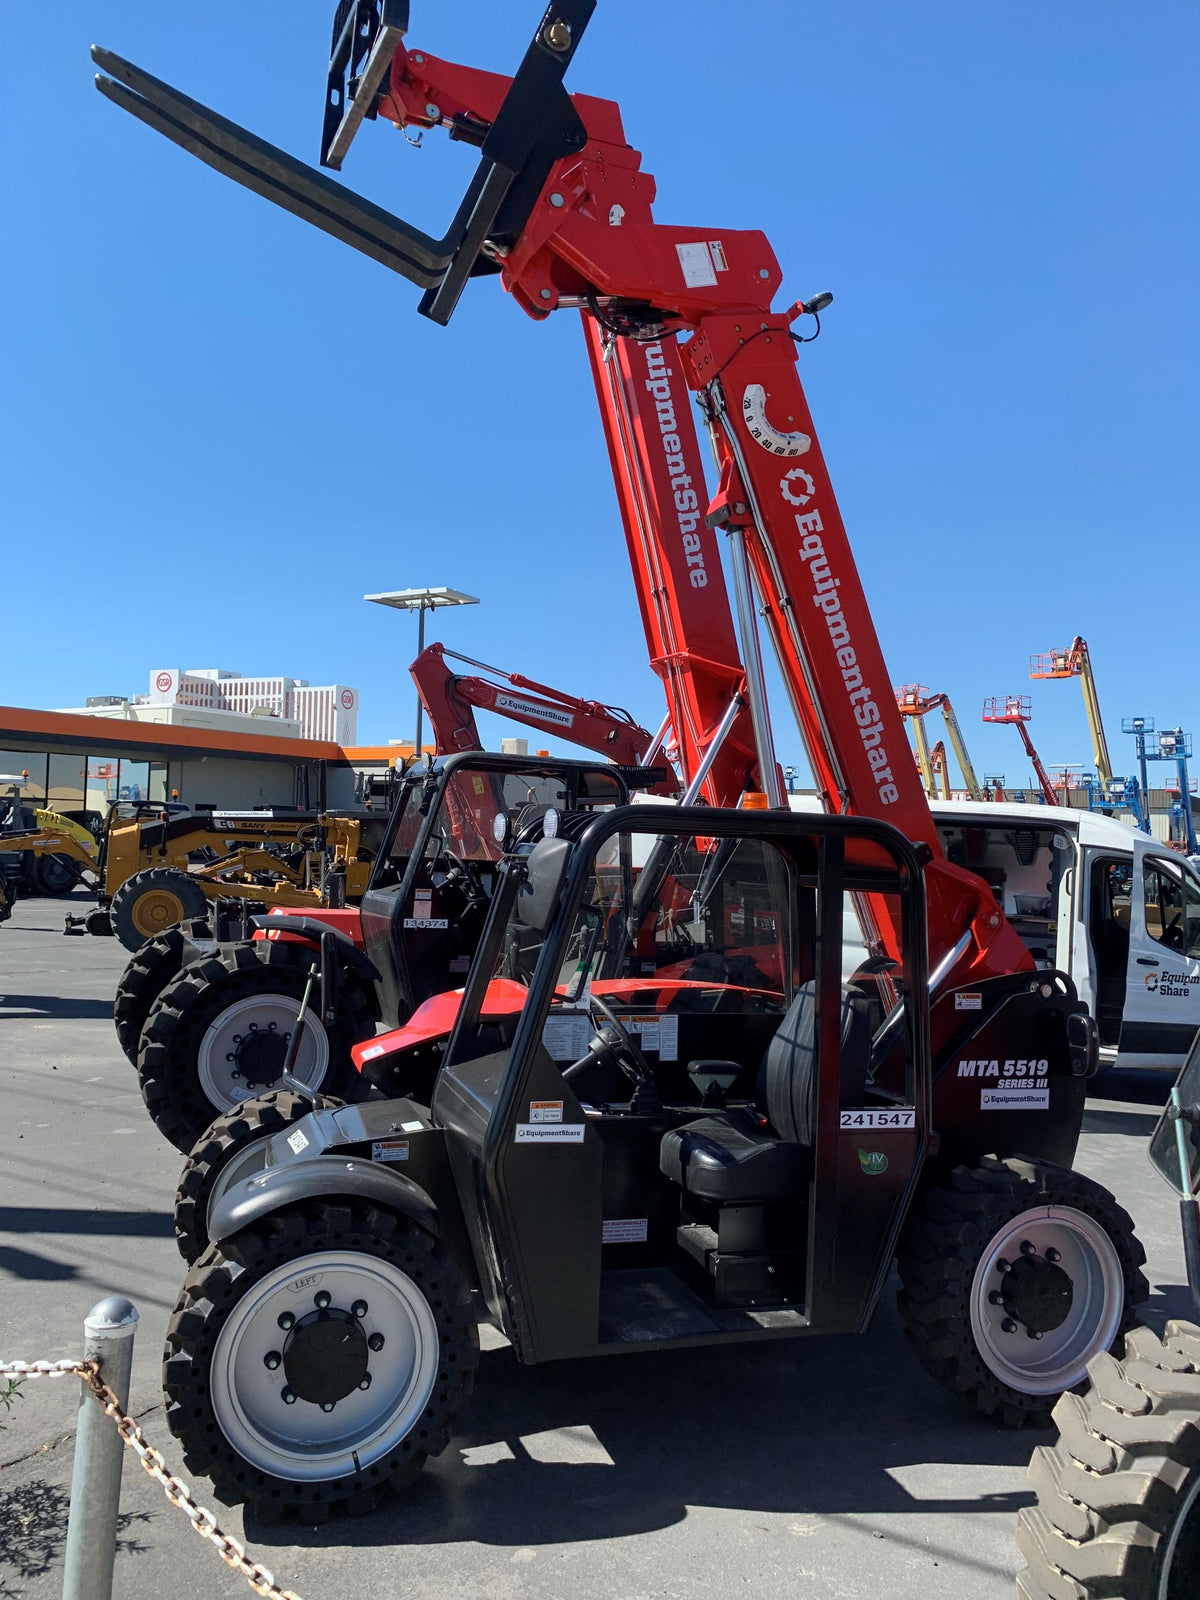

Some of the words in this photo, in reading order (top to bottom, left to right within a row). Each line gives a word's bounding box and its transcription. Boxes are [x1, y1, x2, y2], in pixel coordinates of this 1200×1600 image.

[751, 427, 762, 439] 20
[761, 439, 773, 450] 40
[774, 446, 786, 455] 60
[637, 338, 708, 589] uipmentShare
[794, 508, 899, 805] EquipmentShare
[507, 700, 570, 723] EquipmentShare
[404, 920, 447, 928] 134374
[1160, 984, 1190, 997] Share
[957, 1060, 1000, 1077] MTA
[1002, 1059, 1049, 1076] 5519
[997, 1078, 1035, 1089] SERIES
[990, 1095, 1047, 1103] EquipmentShare
[841, 1113, 913, 1126] 241547
[526, 1129, 581, 1137] EquipmentShare
[295, 1273, 317, 1289] LEFT
